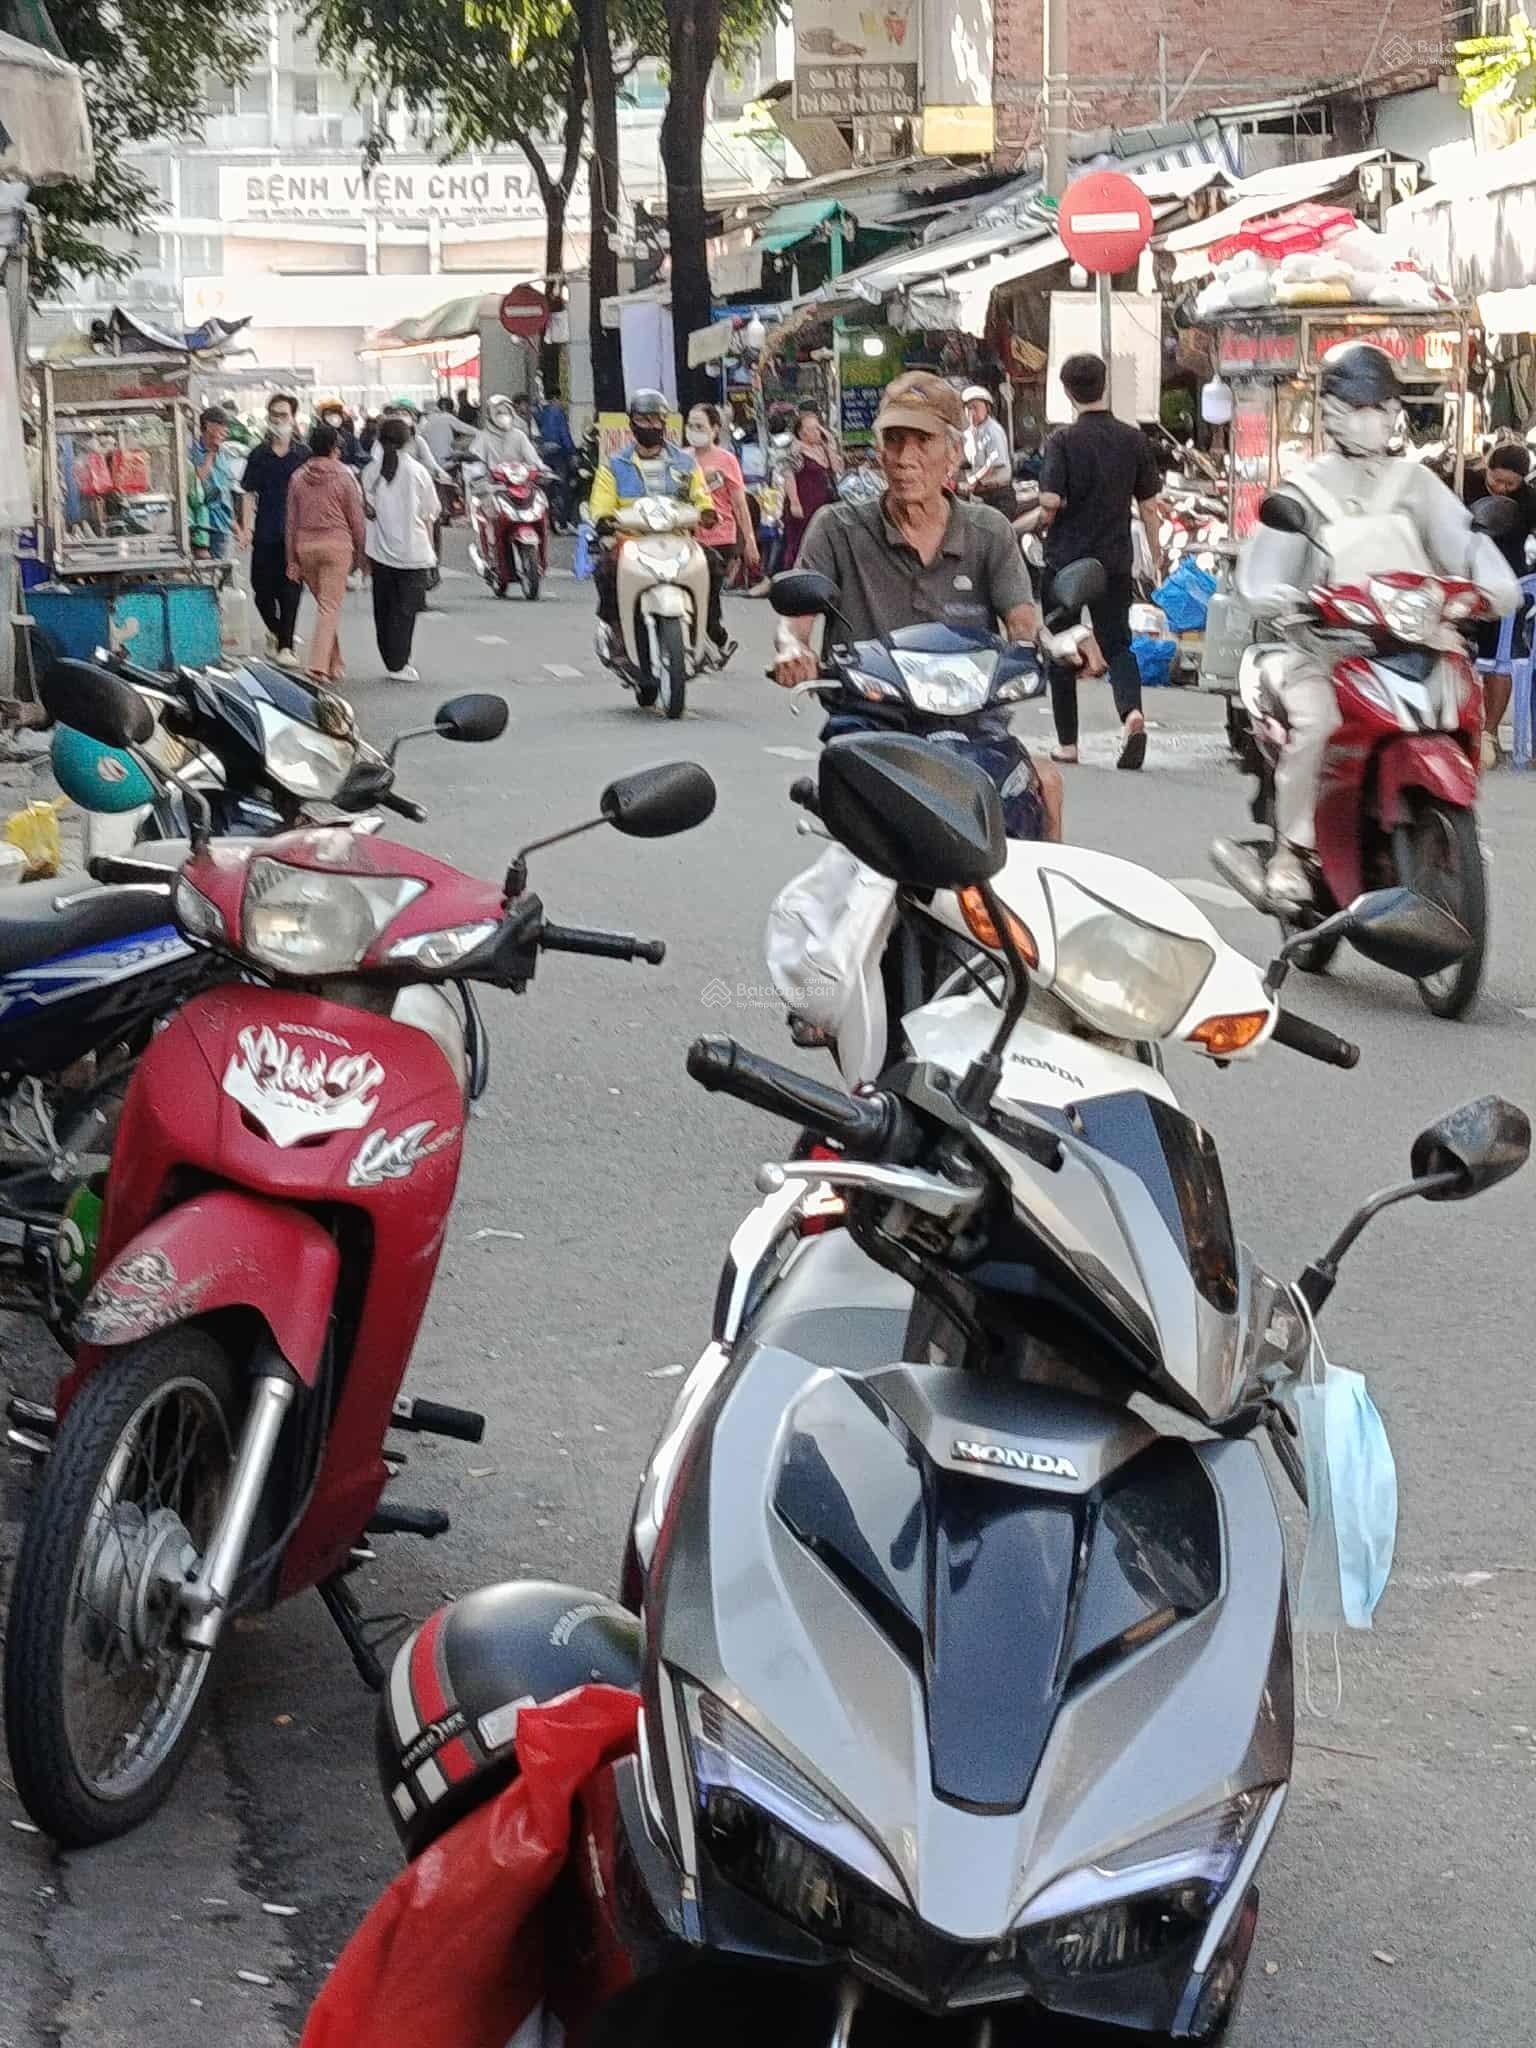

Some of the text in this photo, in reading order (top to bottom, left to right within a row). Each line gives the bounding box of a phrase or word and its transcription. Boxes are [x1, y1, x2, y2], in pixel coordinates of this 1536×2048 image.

[246, 174, 329, 206] BỆNH
[344, 174, 413, 206] VIỆN
[429, 171, 490, 205] CHỢ
[1011, 1053, 1085, 1088] HONDA
[951, 1440, 1081, 1480] HONDA
